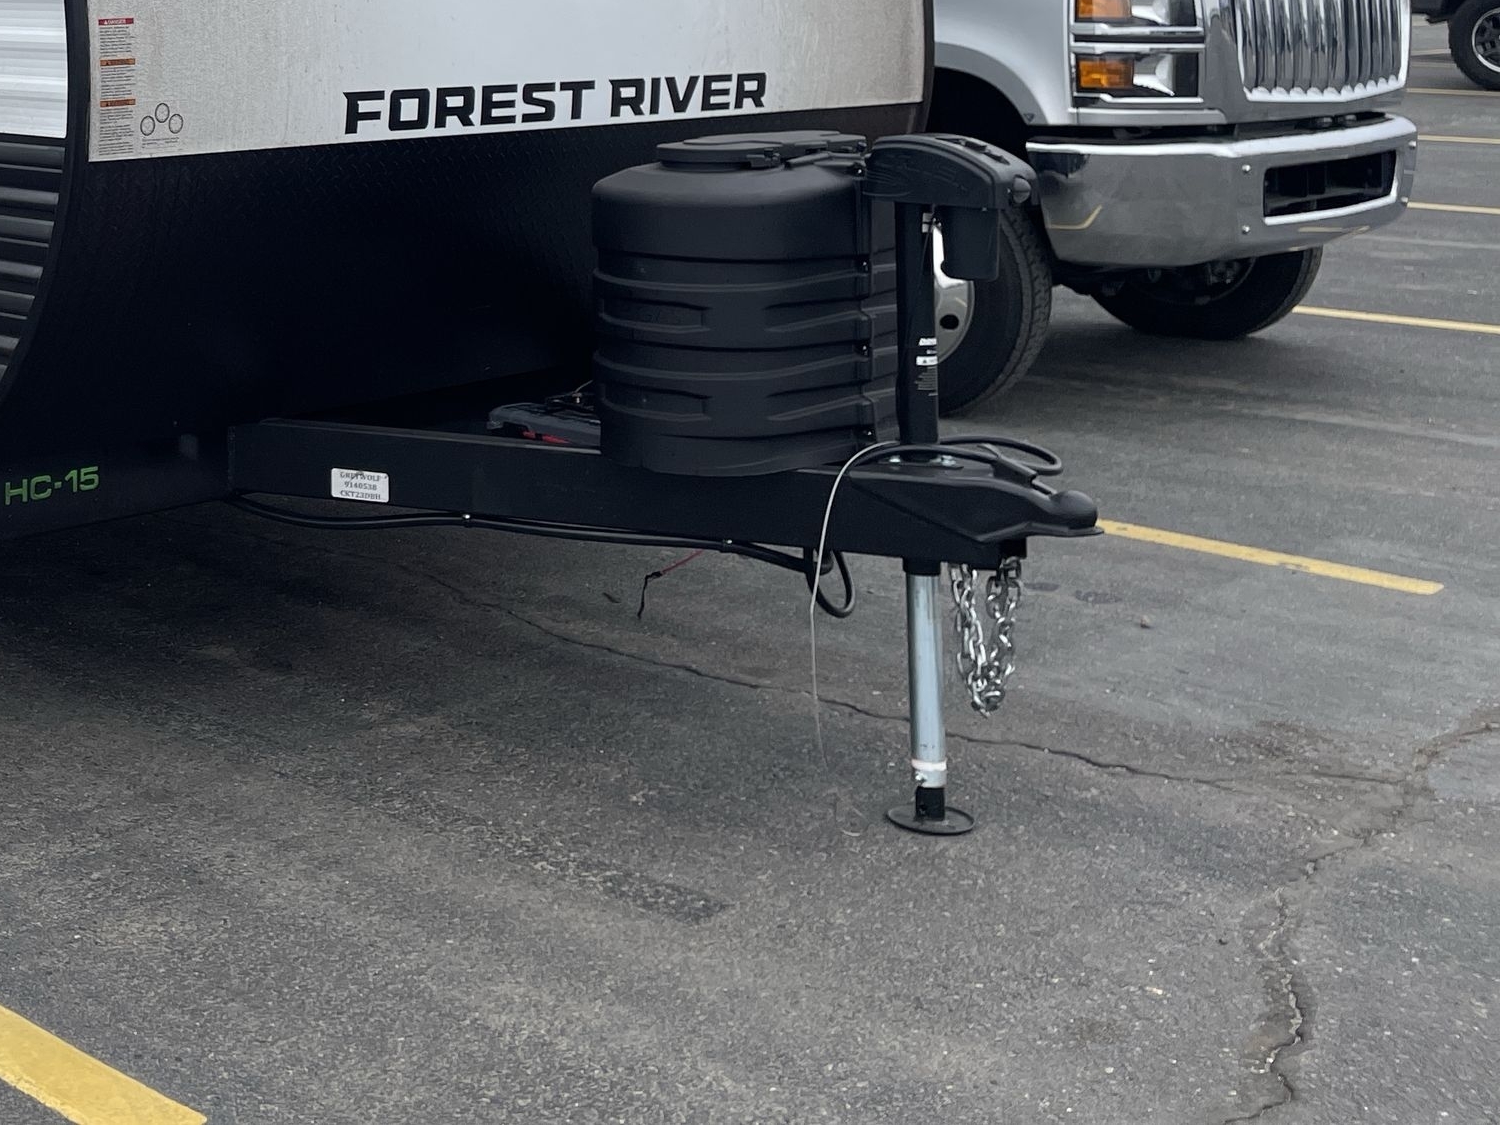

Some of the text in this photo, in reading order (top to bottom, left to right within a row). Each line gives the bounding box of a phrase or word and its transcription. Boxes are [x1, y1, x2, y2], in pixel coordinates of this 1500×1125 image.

[342, 72, 767, 135] FOREST RIVER
[4, 466, 100, 506] HC-15
